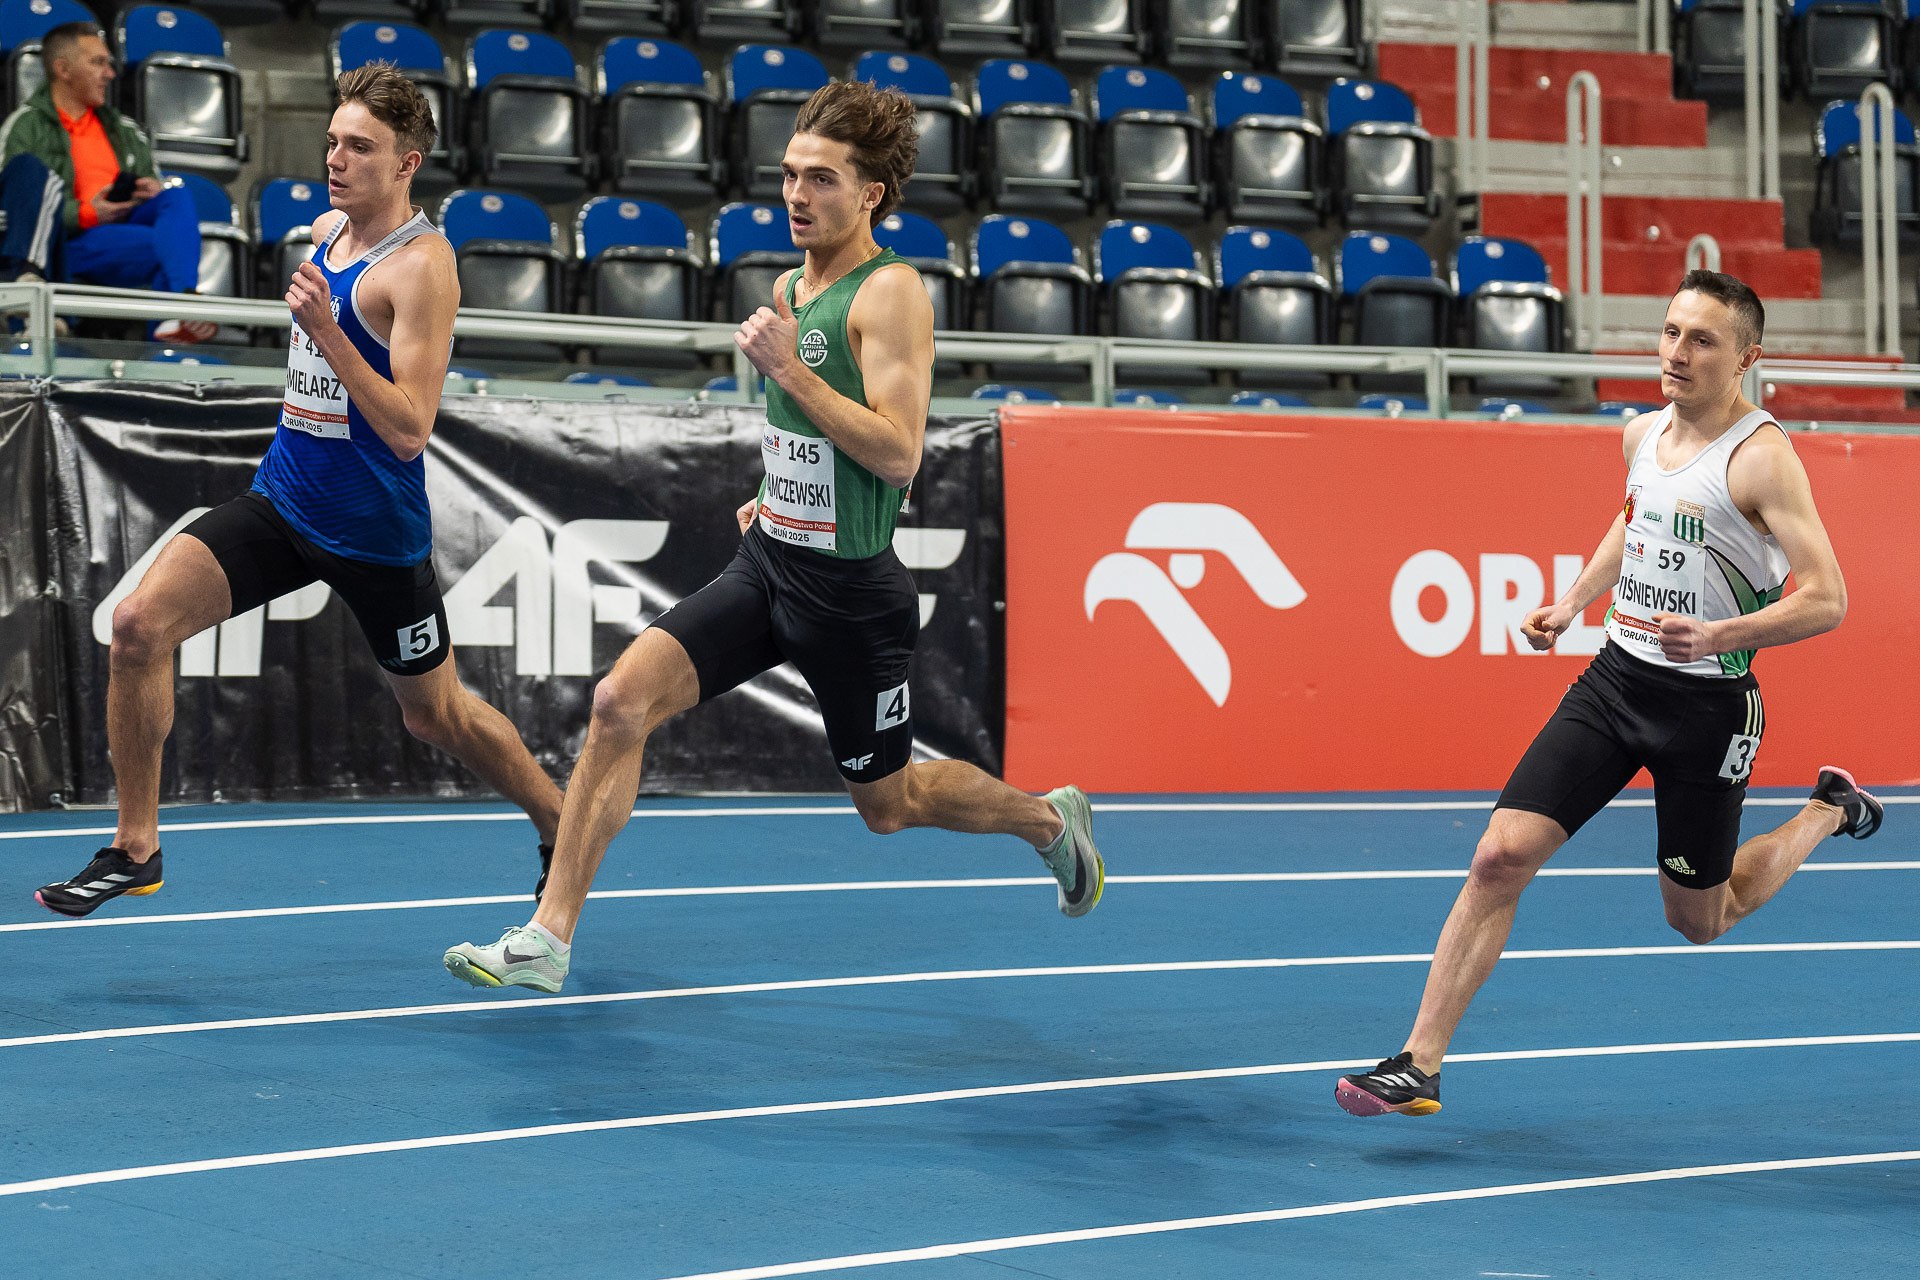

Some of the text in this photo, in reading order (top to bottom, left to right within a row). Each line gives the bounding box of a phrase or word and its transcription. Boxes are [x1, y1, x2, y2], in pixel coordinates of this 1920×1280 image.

[806, 335, 822, 345] AZS
[804, 350, 823, 359] AWF
[788, 440, 820, 465] 145
[814, 523, 833, 531] Polski
[789, 531, 810, 543] 2025
[1657, 549, 1686, 571] 59
[1619, 574, 1696, 614] IŚNIEWSKI
[410, 621, 432, 655] 5
[1619, 628, 1648, 643] TORUŃ
[884, 687, 907, 721] 4
[1730, 739, 1751, 776] 3
[1664, 858, 1696, 875] adidas
